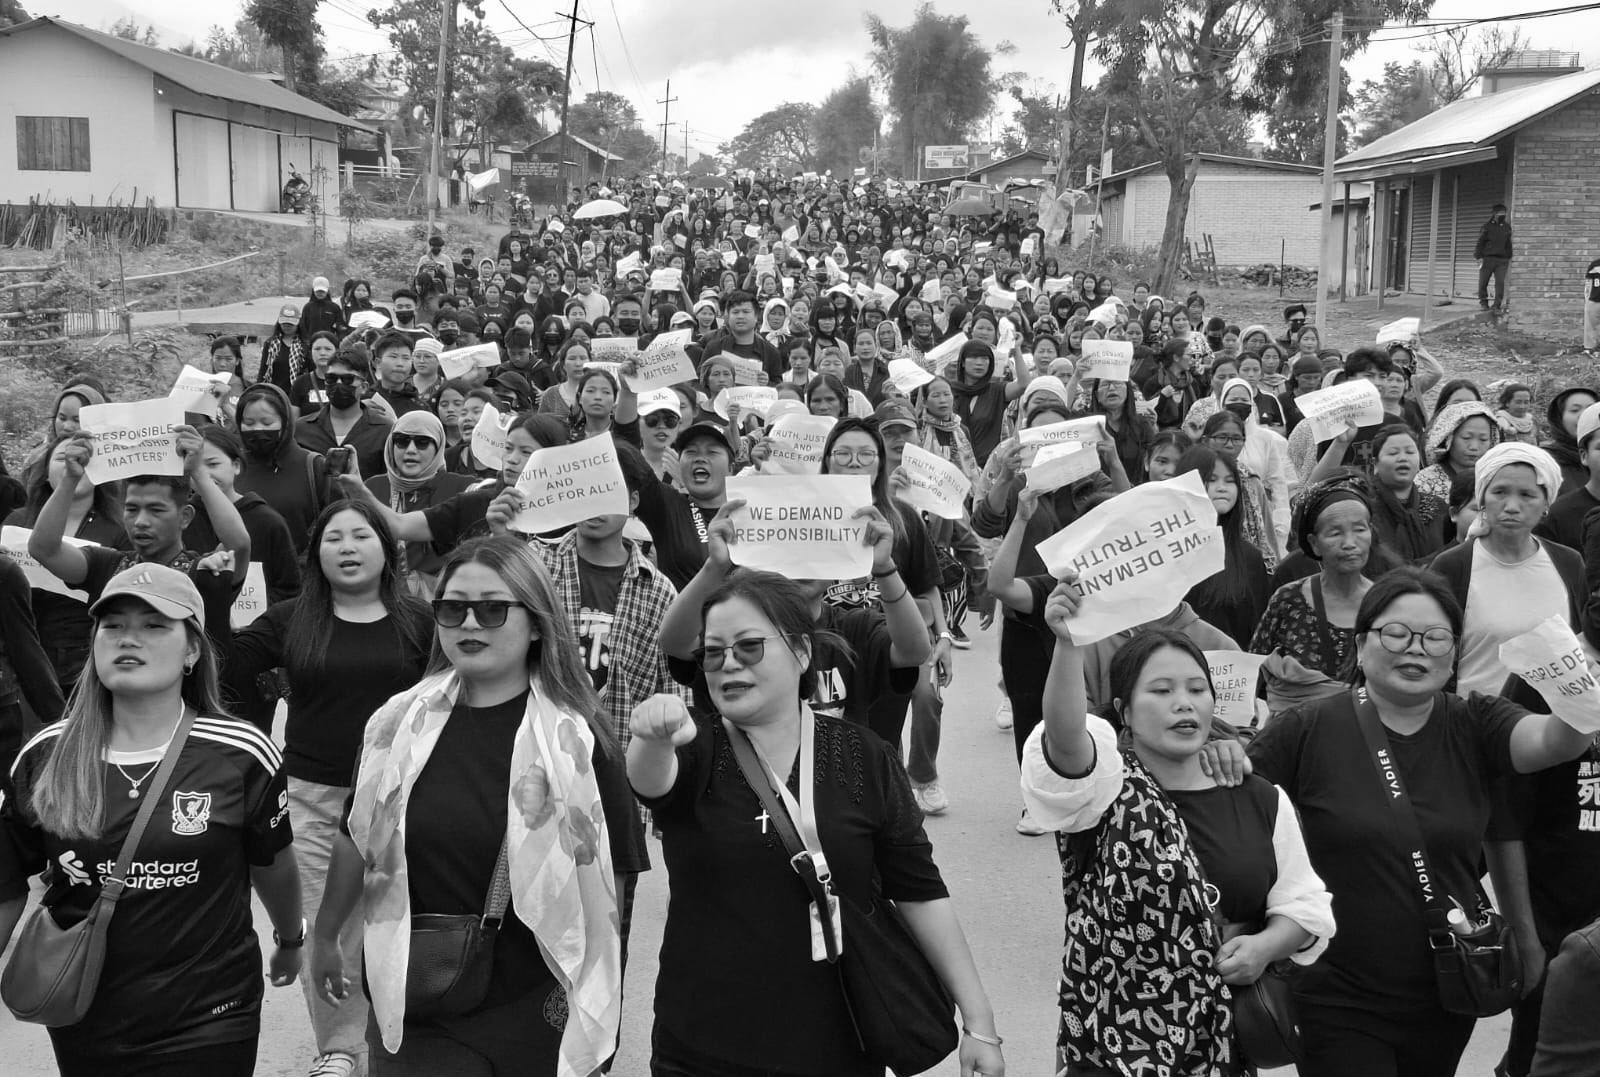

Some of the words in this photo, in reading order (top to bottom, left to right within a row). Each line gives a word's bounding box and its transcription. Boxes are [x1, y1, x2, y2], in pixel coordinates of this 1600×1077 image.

[640, 350, 676, 367] EADERSHIP
[803, 433, 826, 443] JUST
[1042, 430, 1080, 440] VOICES
[793, 443, 812, 453] AND
[773, 449, 796, 460] EACE
[797, 455, 816, 463] FOR
[520, 467, 553, 482] RUTH,
[556, 452, 615, 476] JUSTICE,
[546, 477, 573, 491] AND
[519, 493, 556, 512] EACE
[558, 487, 586, 502] FOR
[750, 506, 773, 521] WE
[779, 506, 843, 520] DEMAND
[1149, 509, 1197, 539] THE
[736, 527, 861, 541] RESPONSIBILITY
[1072, 530, 1148, 573] TRUTH
[830, 582, 856, 597] LIBER
[234, 600, 257, 610] IRST
[1561, 647, 1585, 671] DE
[1210, 663, 1235, 676] RUST
[1215, 677, 1248, 690] CLEAR
[1557, 673, 1596, 697] ANSW
[1215, 692, 1246, 702] ABLE
[1213, 705, 1228, 715] CE
[97, 859, 199, 875] stndard
[99, 871, 200, 890] cartered
